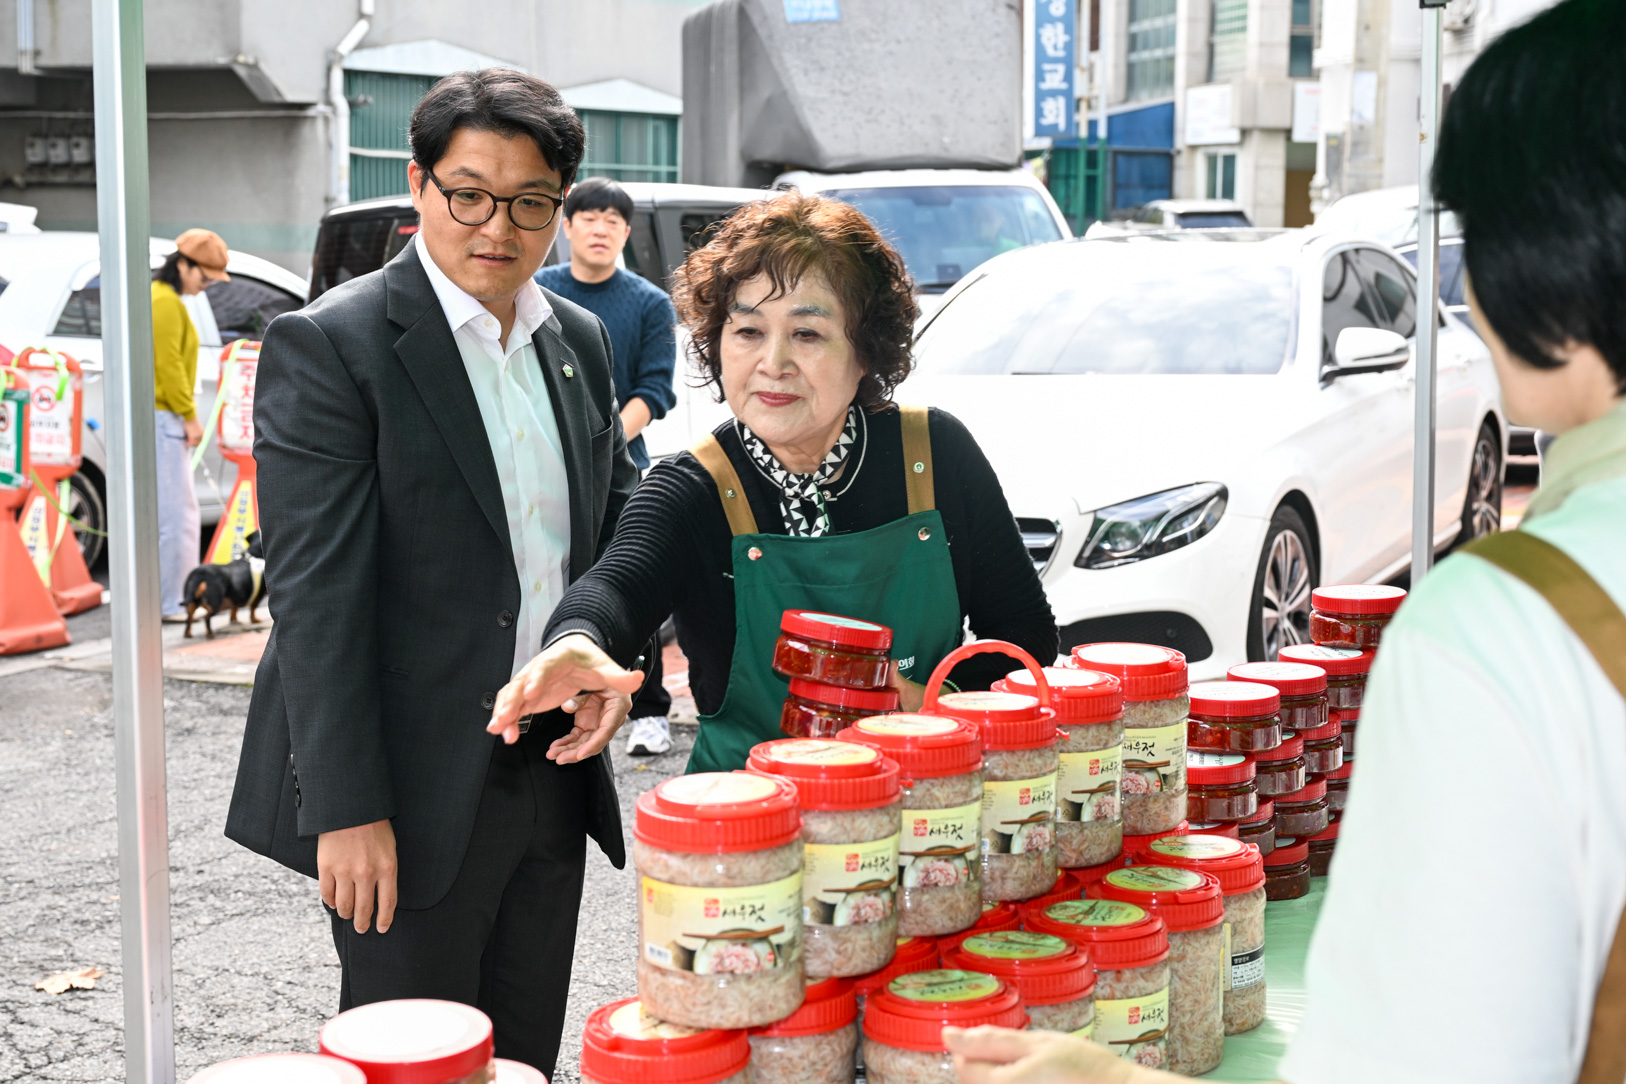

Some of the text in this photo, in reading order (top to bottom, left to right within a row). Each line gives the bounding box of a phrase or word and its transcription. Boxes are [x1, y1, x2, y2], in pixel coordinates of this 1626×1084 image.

[1031, 790, 1054, 806] 새우젓
[929, 823, 964, 841] 새우젓
[860, 855, 891, 873] 새우젓
[721, 903, 766, 923] 새우젓
[1141, 1006, 1165, 1024] 새우젓
